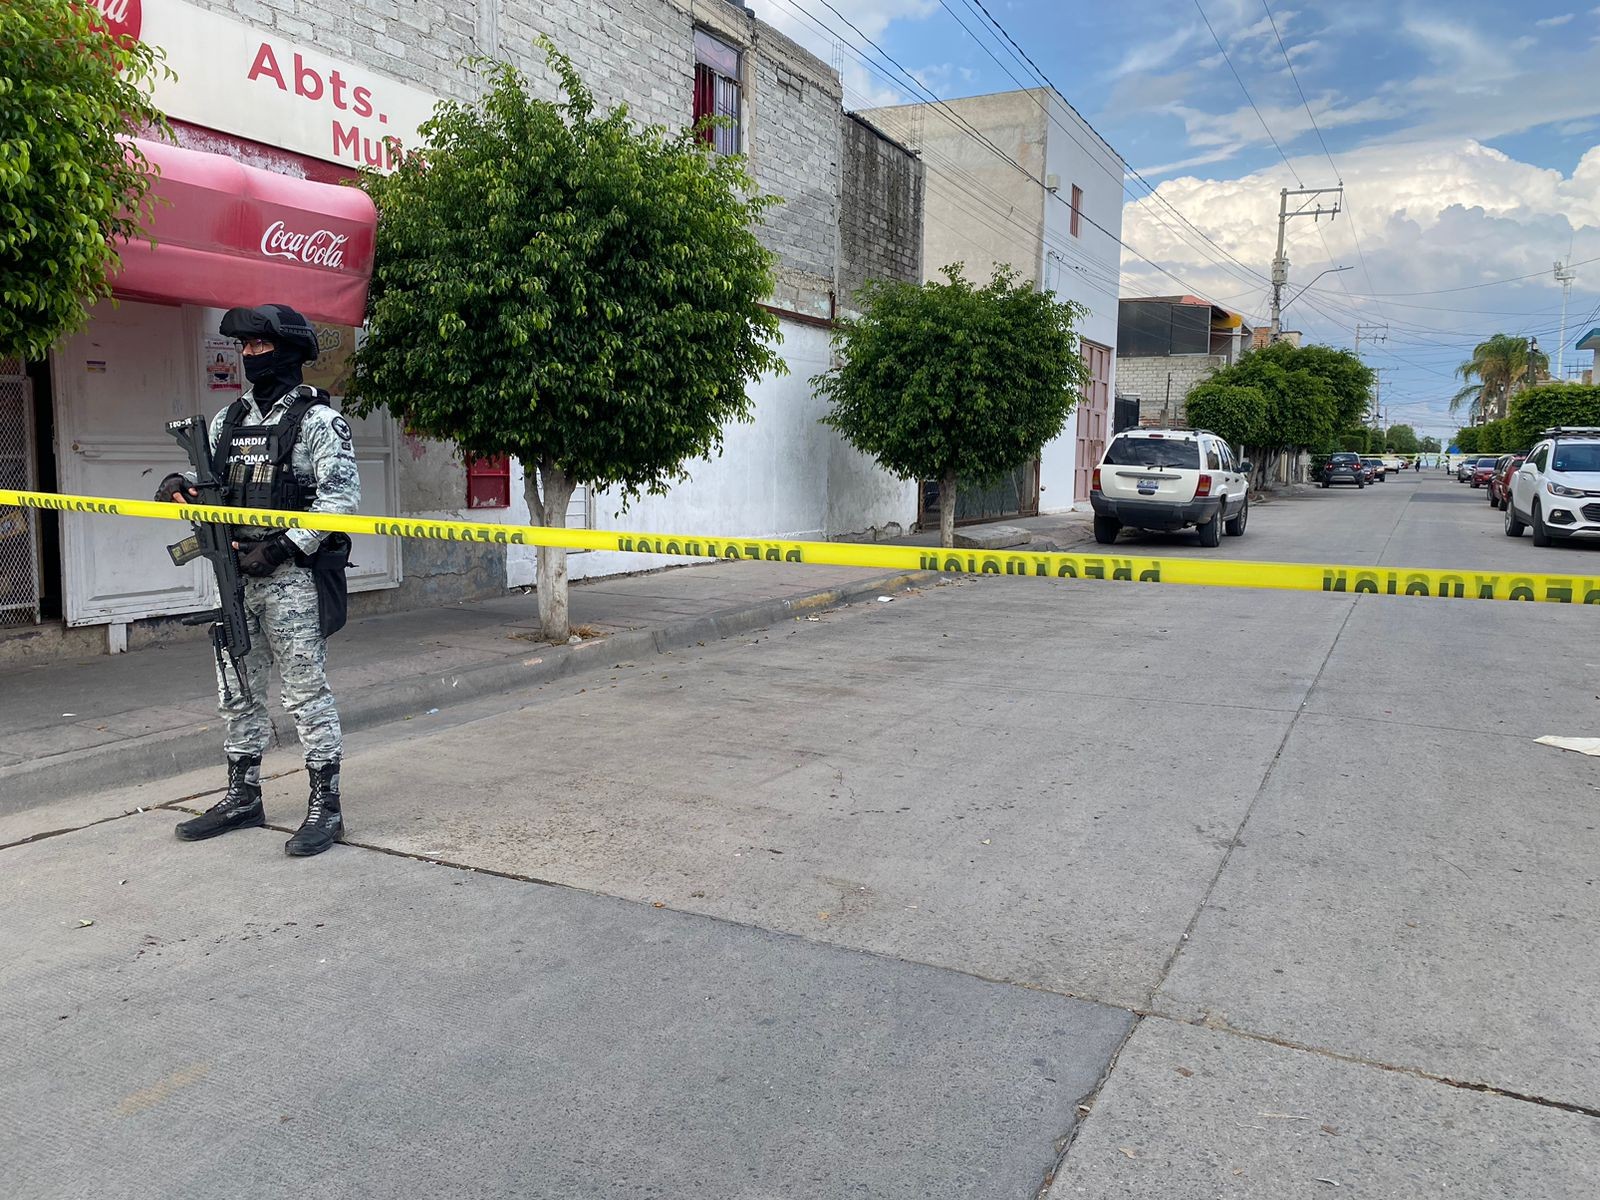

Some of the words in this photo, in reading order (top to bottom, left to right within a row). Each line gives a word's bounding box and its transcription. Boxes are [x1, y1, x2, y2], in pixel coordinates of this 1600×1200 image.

[247, 42, 388, 124] Abts.
[332, 119, 426, 176] Muñ
[230, 437, 267, 447] UARDIA
